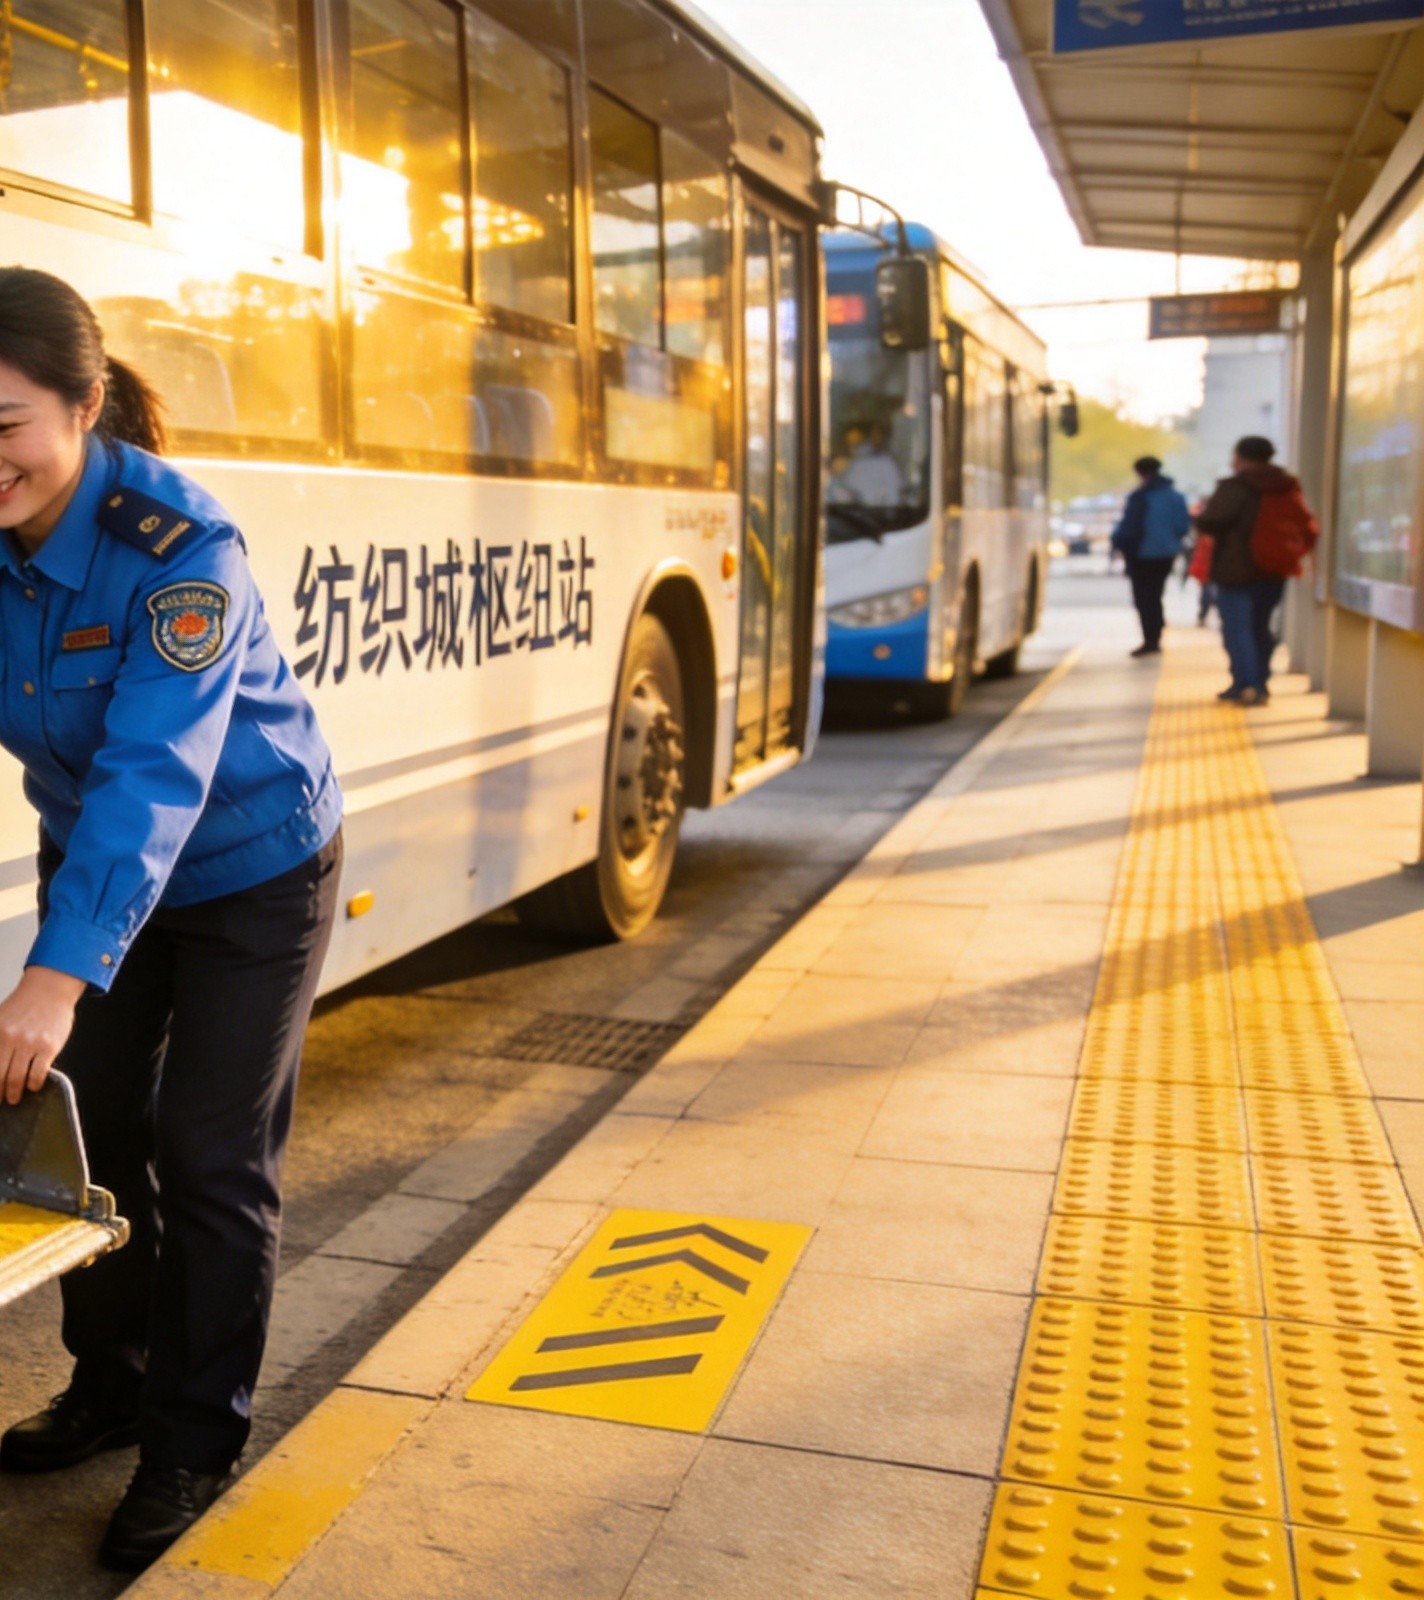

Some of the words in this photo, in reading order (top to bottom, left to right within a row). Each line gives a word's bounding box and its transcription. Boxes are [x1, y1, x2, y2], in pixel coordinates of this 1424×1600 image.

[293, 535, 595, 688] 纺织城枢纽站
